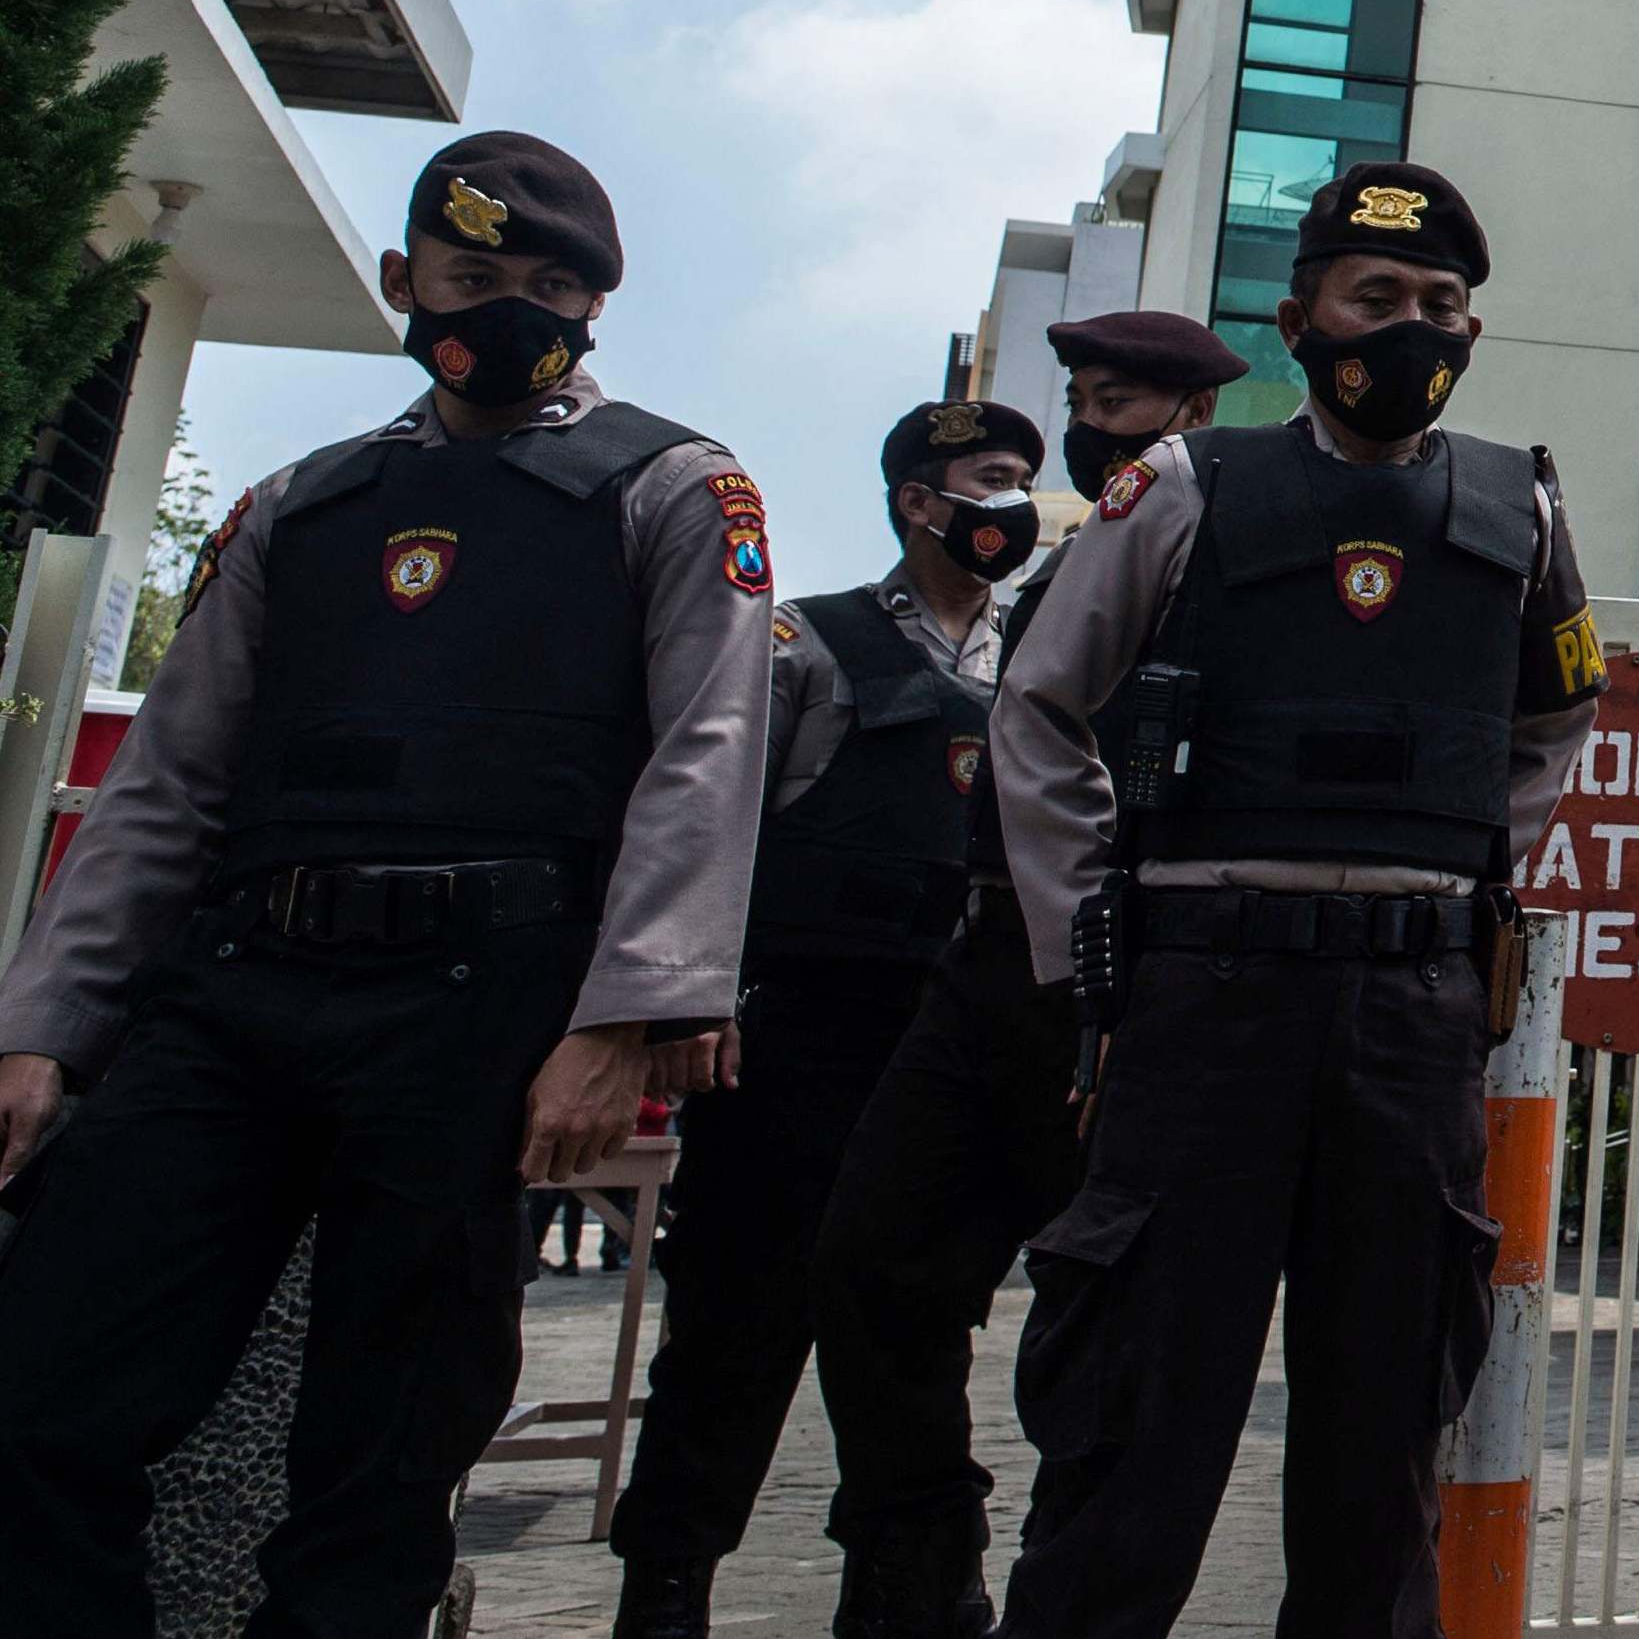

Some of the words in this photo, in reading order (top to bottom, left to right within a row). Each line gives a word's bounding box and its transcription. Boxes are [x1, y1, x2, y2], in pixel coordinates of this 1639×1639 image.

[387, 529, 418, 545] KORPS
[1337, 540, 1366, 554] KORPS
[1366, 541, 1404, 559] SABHARA
[1556, 615, 1606, 694] PA
